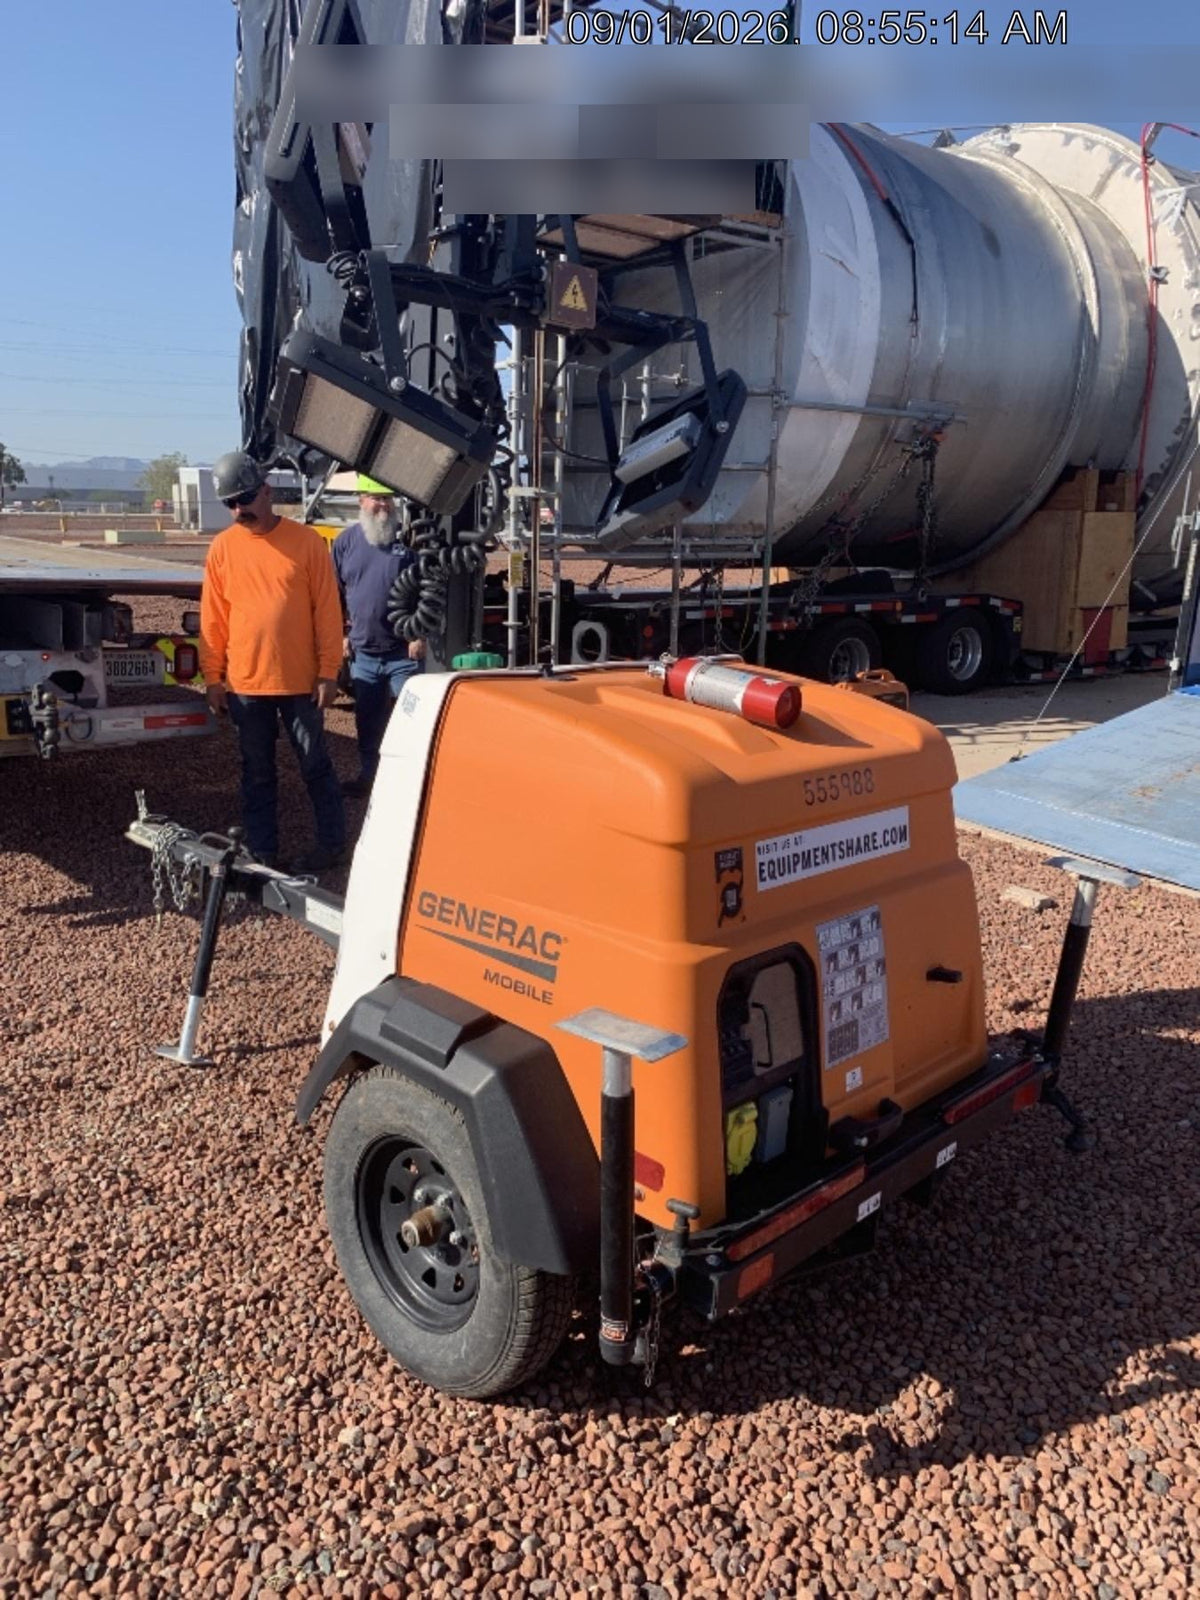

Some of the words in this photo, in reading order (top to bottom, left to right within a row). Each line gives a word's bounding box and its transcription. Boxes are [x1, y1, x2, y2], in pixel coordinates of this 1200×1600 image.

[803, 767, 876, 806] 555988
[758, 824, 908, 883] EQUIPMENTSHARE.COM
[417, 890, 562, 962] GENERAC
[483, 968, 554, 1006] MOBILE
